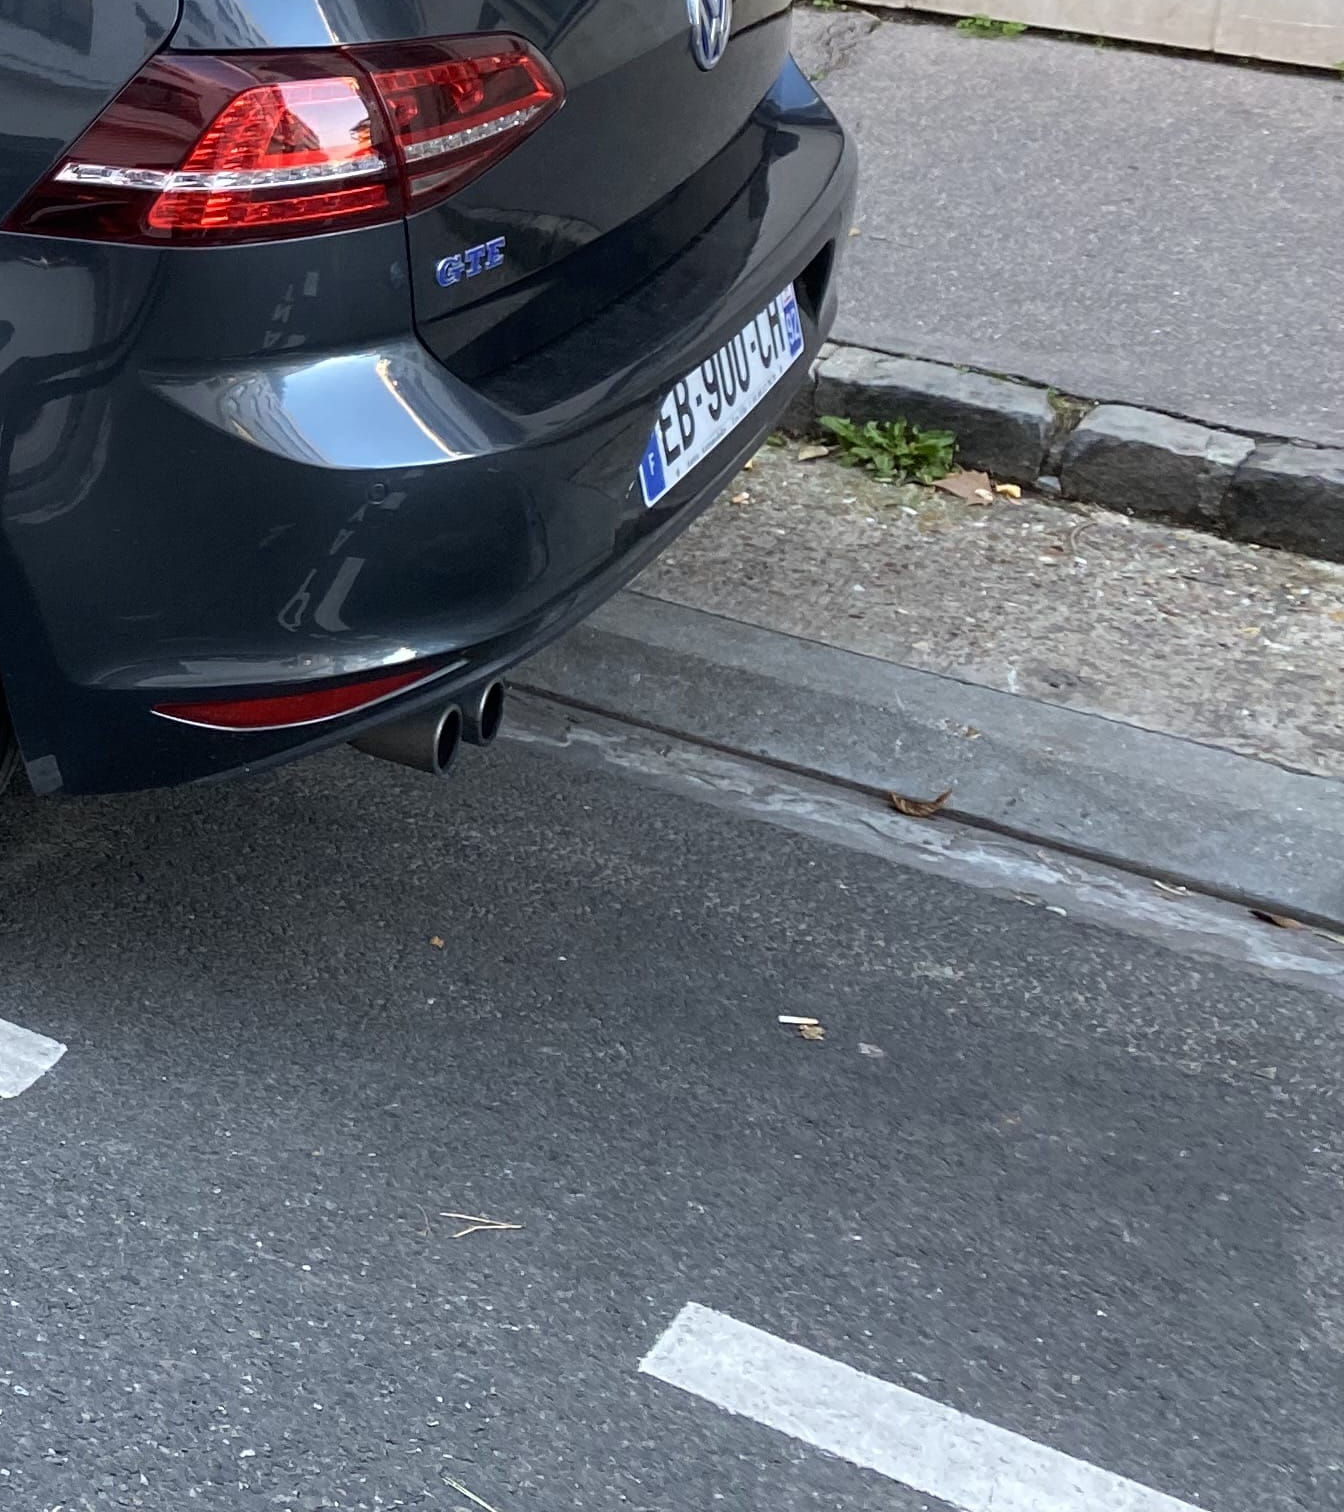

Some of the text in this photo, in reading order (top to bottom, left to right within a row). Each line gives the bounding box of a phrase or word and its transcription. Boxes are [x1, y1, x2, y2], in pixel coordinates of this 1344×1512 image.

[436, 235, 506, 287] GTE
[659, 299, 785, 467] EB-900-CH
[648, 452, 655, 476] F
